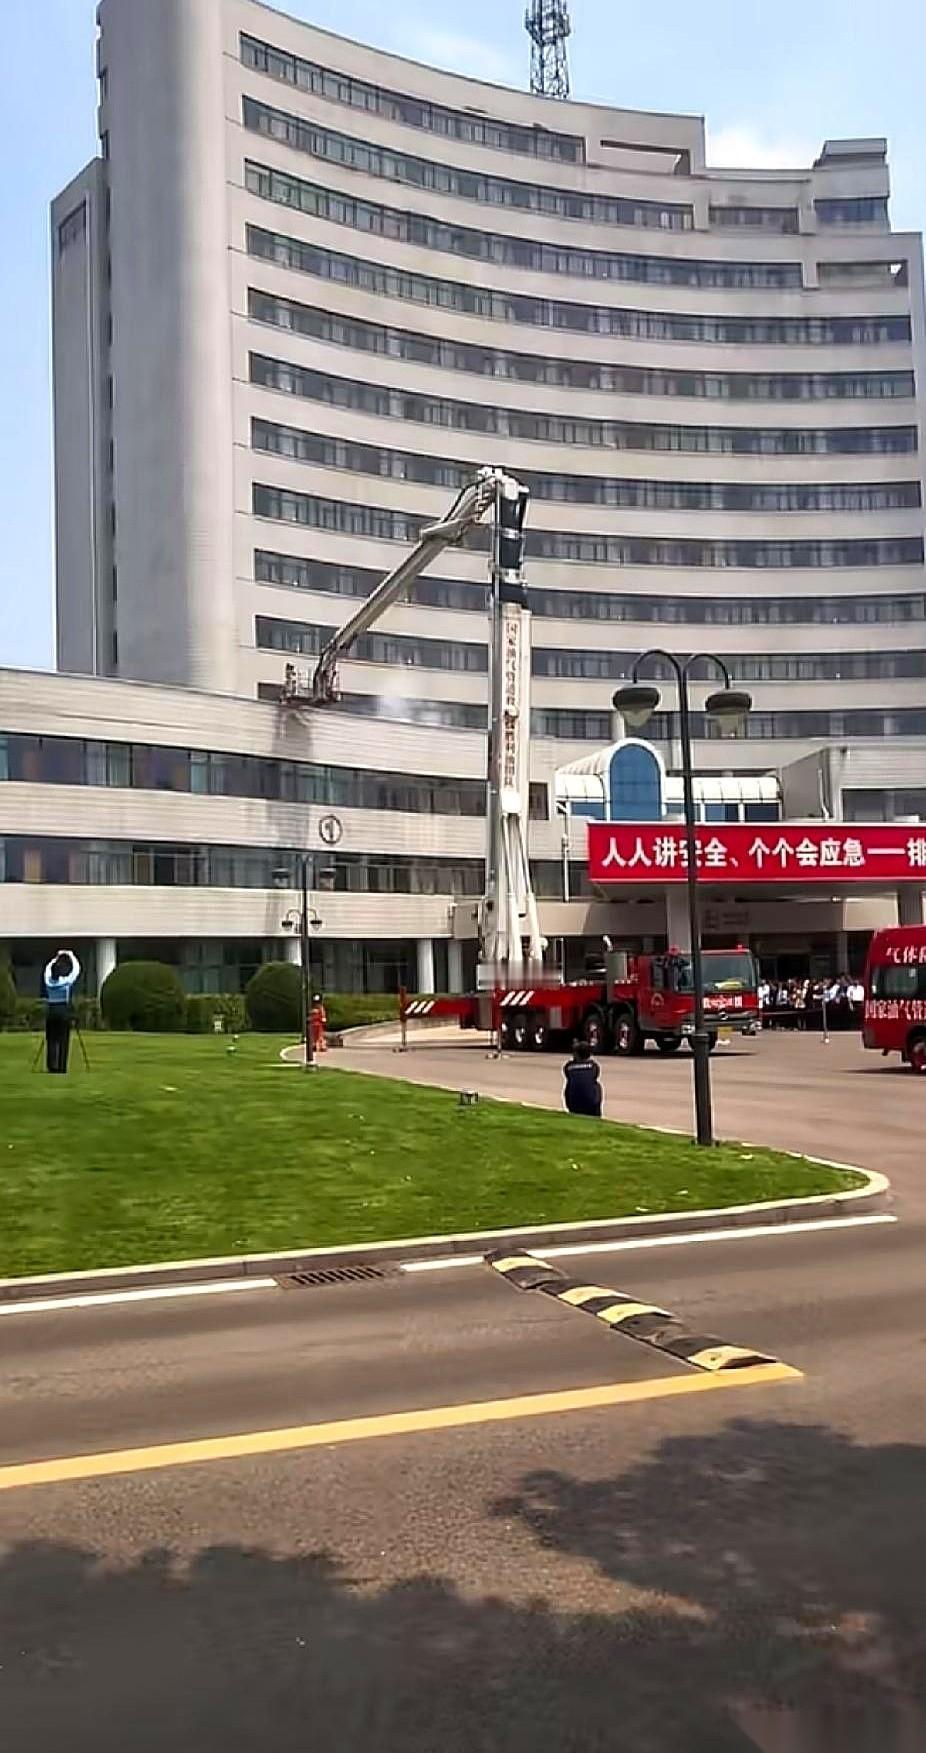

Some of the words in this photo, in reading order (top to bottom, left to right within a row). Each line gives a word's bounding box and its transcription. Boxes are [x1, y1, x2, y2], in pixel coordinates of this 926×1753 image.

[865, 999, 926, 1020] 国家油气管
